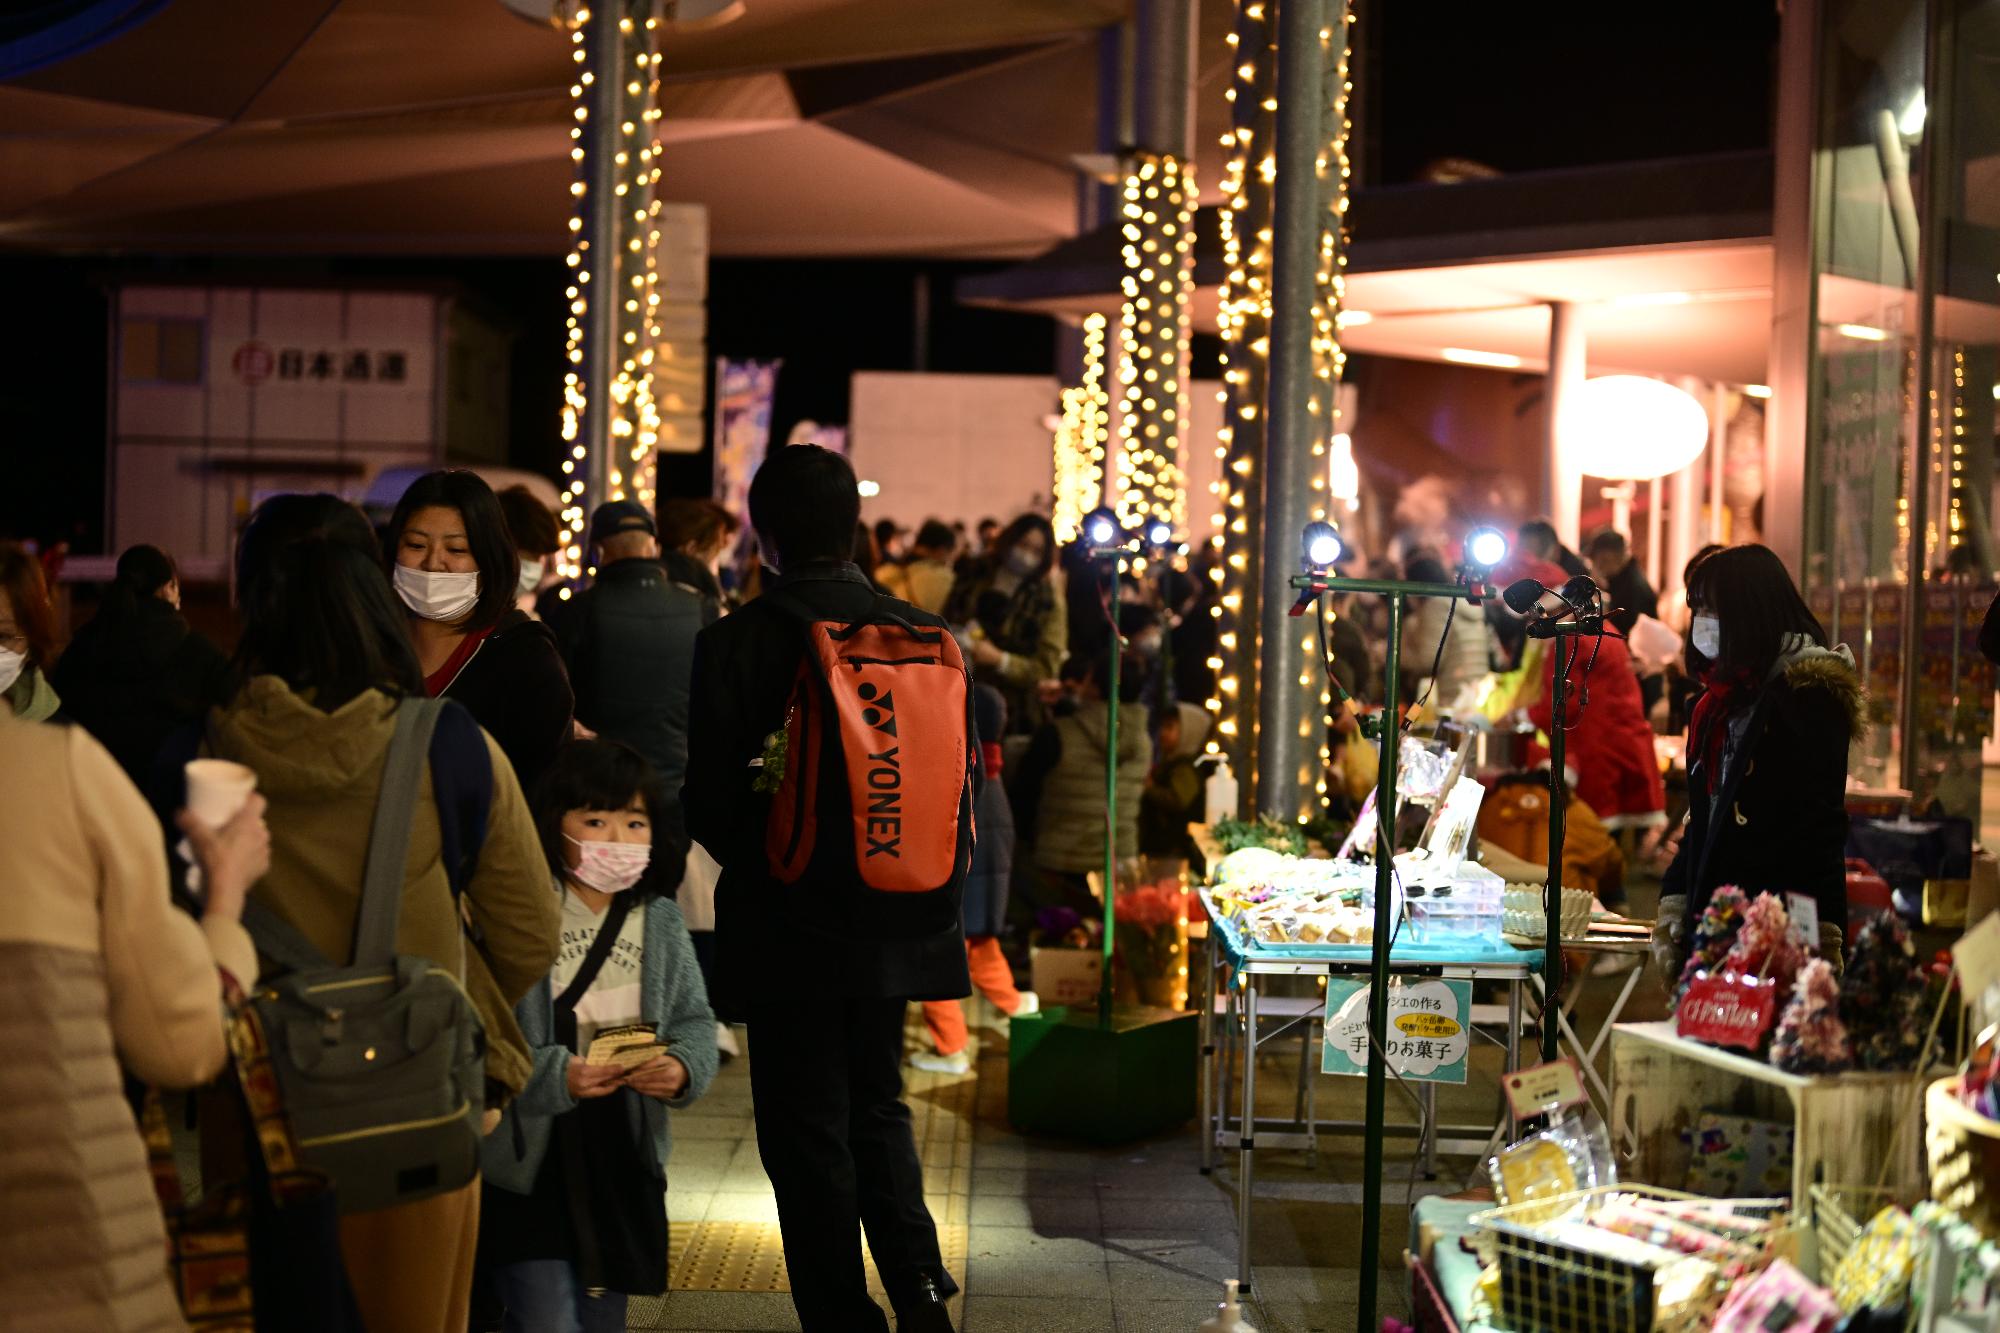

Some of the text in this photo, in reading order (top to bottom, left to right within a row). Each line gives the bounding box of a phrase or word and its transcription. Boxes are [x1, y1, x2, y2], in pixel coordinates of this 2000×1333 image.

[866, 747, 901, 858] YONEX
[1350, 1036, 1451, 1060] 手りお菓子
